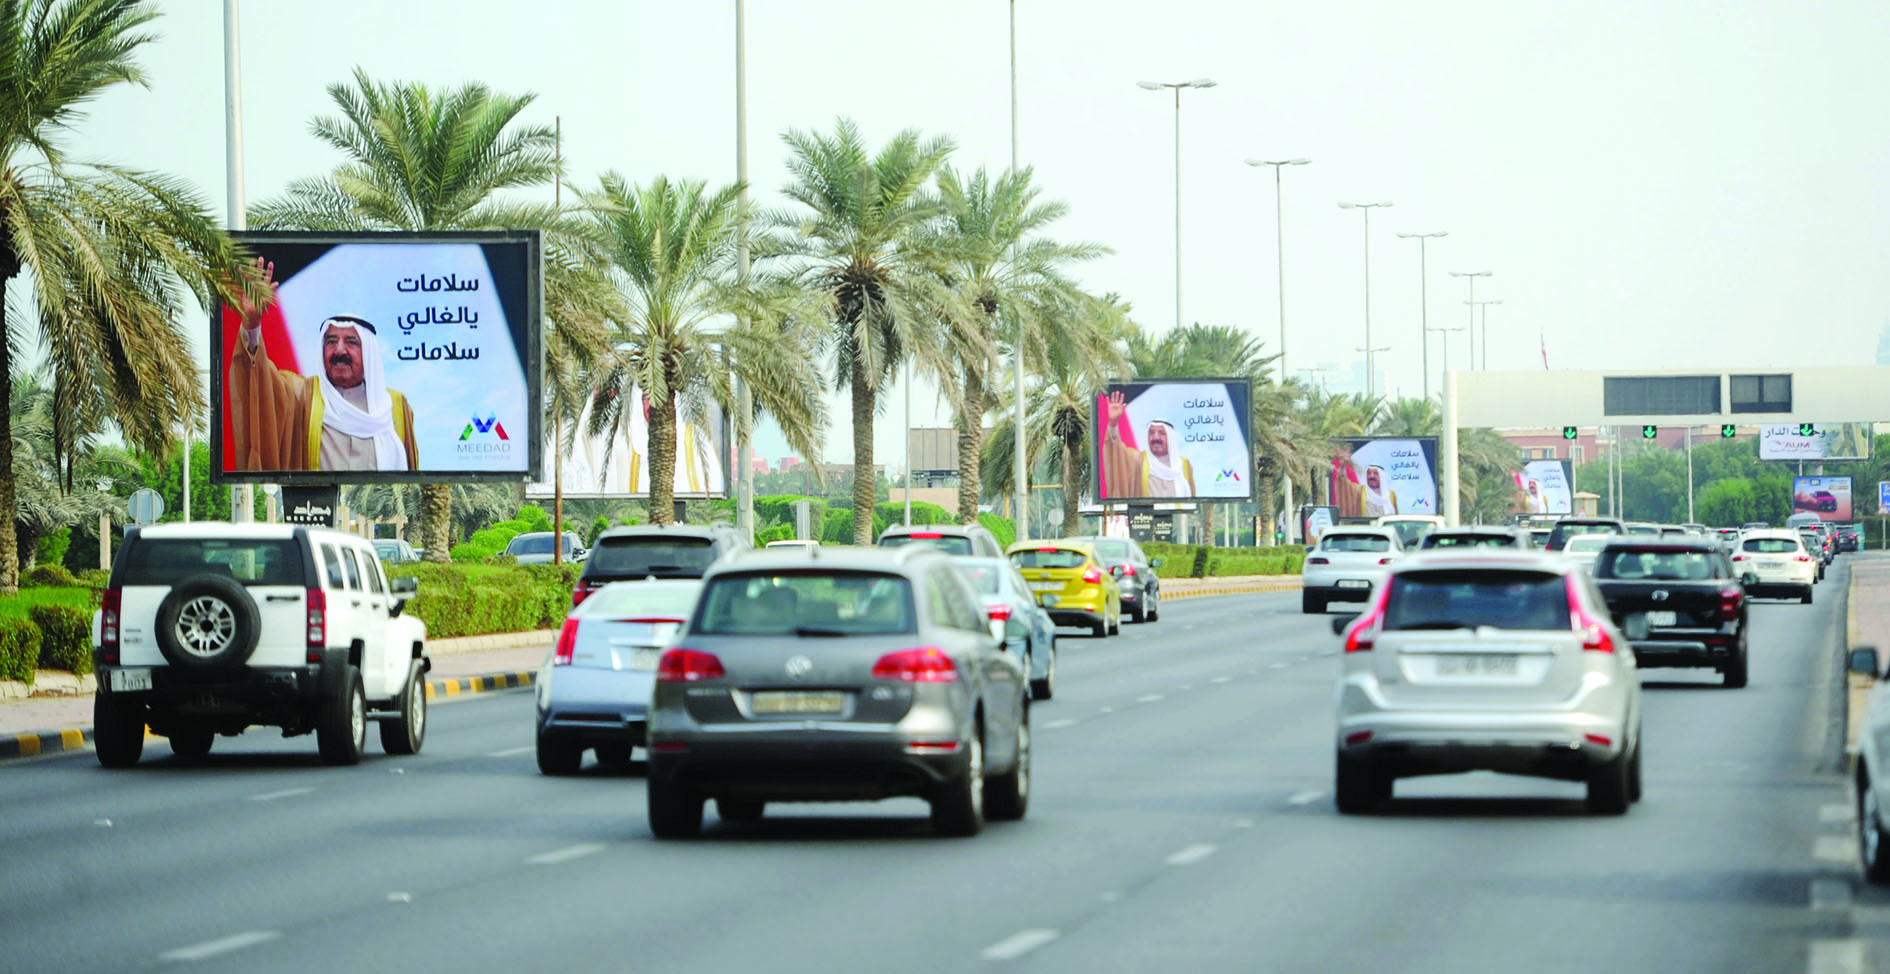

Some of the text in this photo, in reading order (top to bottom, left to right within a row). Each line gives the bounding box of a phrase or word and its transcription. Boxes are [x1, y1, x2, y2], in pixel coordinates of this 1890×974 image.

[397, 273, 479, 292] سلامات
[397, 306, 478, 335] يالغالي
[397, 342, 479, 360] سلامات
[1184, 398, 1224, 408] سلامات
[1184, 415, 1224, 429] يالغالي
[1185, 432, 1224, 442] سلامات
[457, 443, 510, 453] MEEDAD
